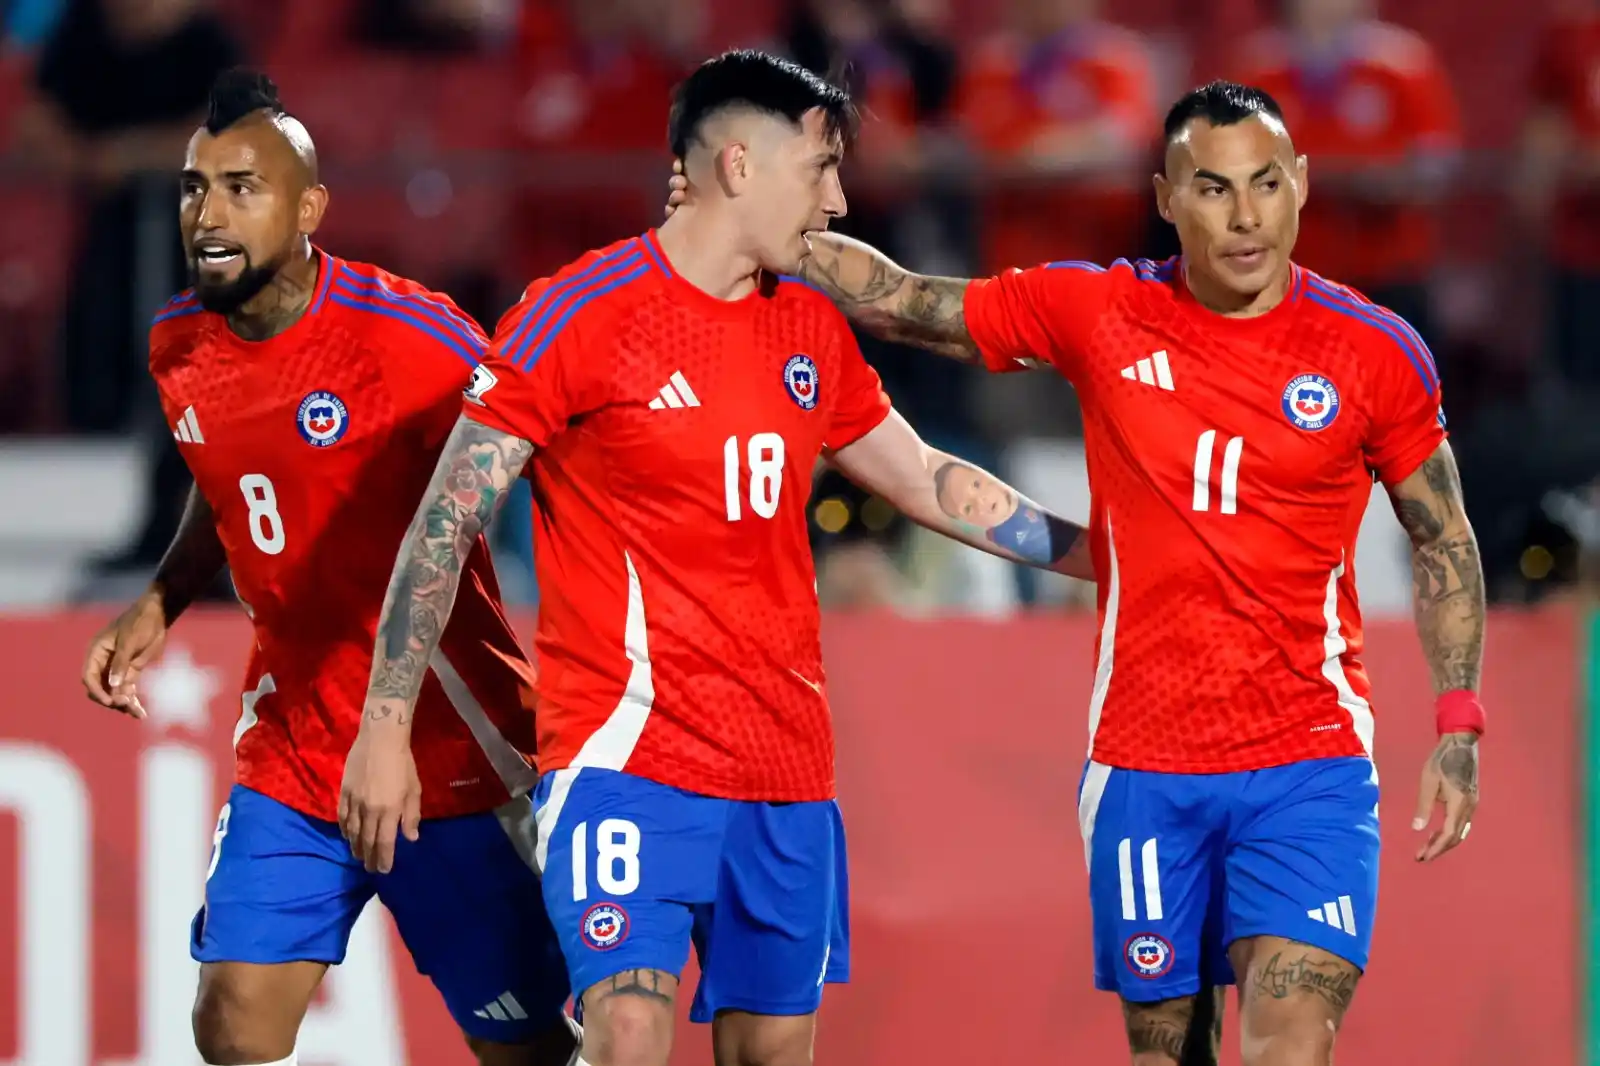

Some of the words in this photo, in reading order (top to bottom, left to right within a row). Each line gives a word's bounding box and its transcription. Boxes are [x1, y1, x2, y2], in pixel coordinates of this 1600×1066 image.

[239, 473, 286, 555] 8
[724, 432, 785, 521] 18
[1192, 429, 1244, 515] 11
[572, 818, 641, 902] 18
[1118, 837, 1163, 921] 11
